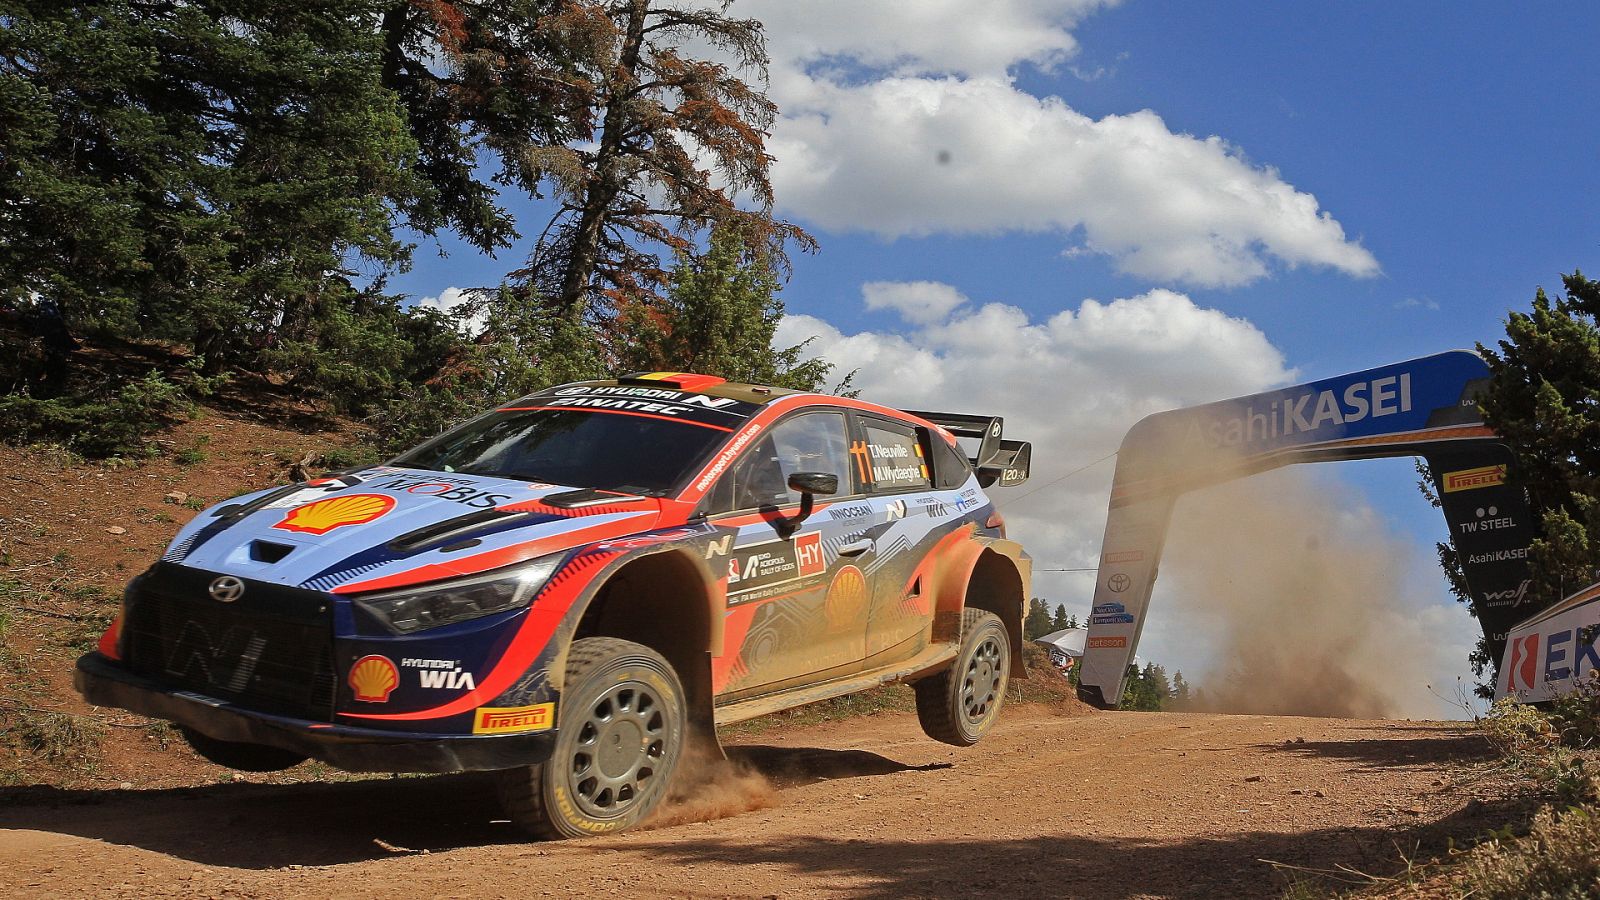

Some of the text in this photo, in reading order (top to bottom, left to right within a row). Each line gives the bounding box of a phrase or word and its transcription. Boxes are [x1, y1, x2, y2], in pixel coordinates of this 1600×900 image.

[590, 387, 683, 400] HYUNDAI
[547, 398, 689, 415] FANATEC
[697, 423, 761, 492] motorsport.hyundai.com
[867, 444, 908, 459] T.Neuville
[850, 440, 873, 484] 11
[873, 464, 921, 484] M.Wydaeghe
[372, 479, 511, 508] MOBIS
[964, 497, 980, 508] STEEL
[828, 505, 873, 521] INNOCEAN
[1460, 517, 1516, 533] TW STEEL
[797, 542, 819, 567] HY
[1468, 548, 1527, 564] AsahiKASEI
[401, 657, 458, 669] HYUNDAI
[481, 707, 546, 729] PIRELLI
